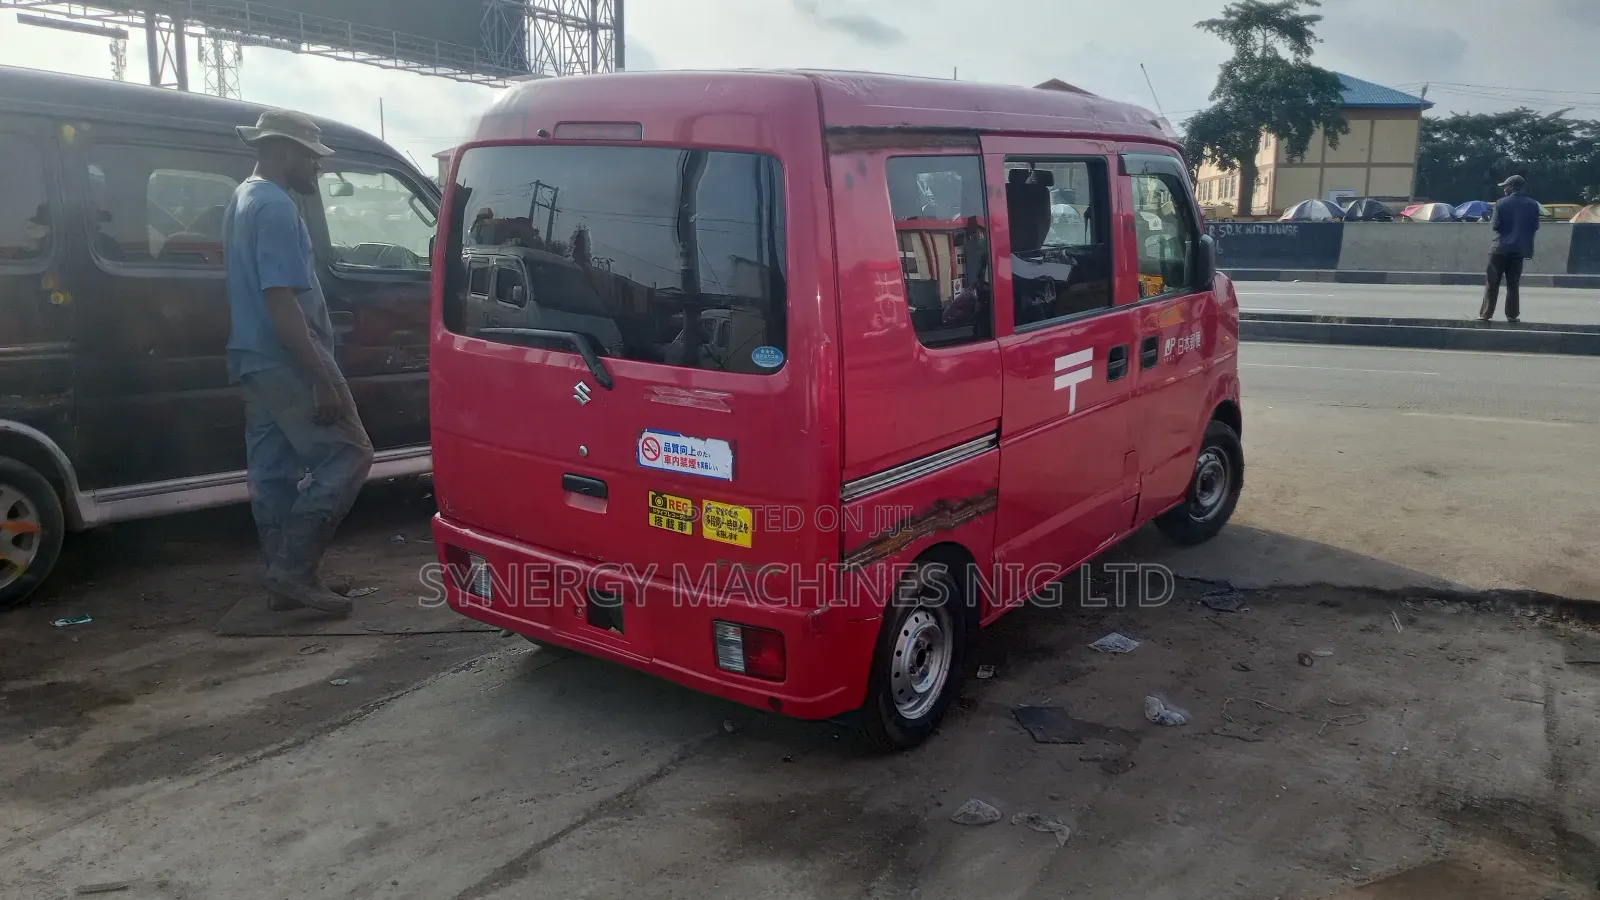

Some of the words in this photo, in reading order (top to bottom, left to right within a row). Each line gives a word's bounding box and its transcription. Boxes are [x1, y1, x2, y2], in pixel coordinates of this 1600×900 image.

[668, 499, 689, 514] REC
[654, 514, 688, 532] 搭載車
